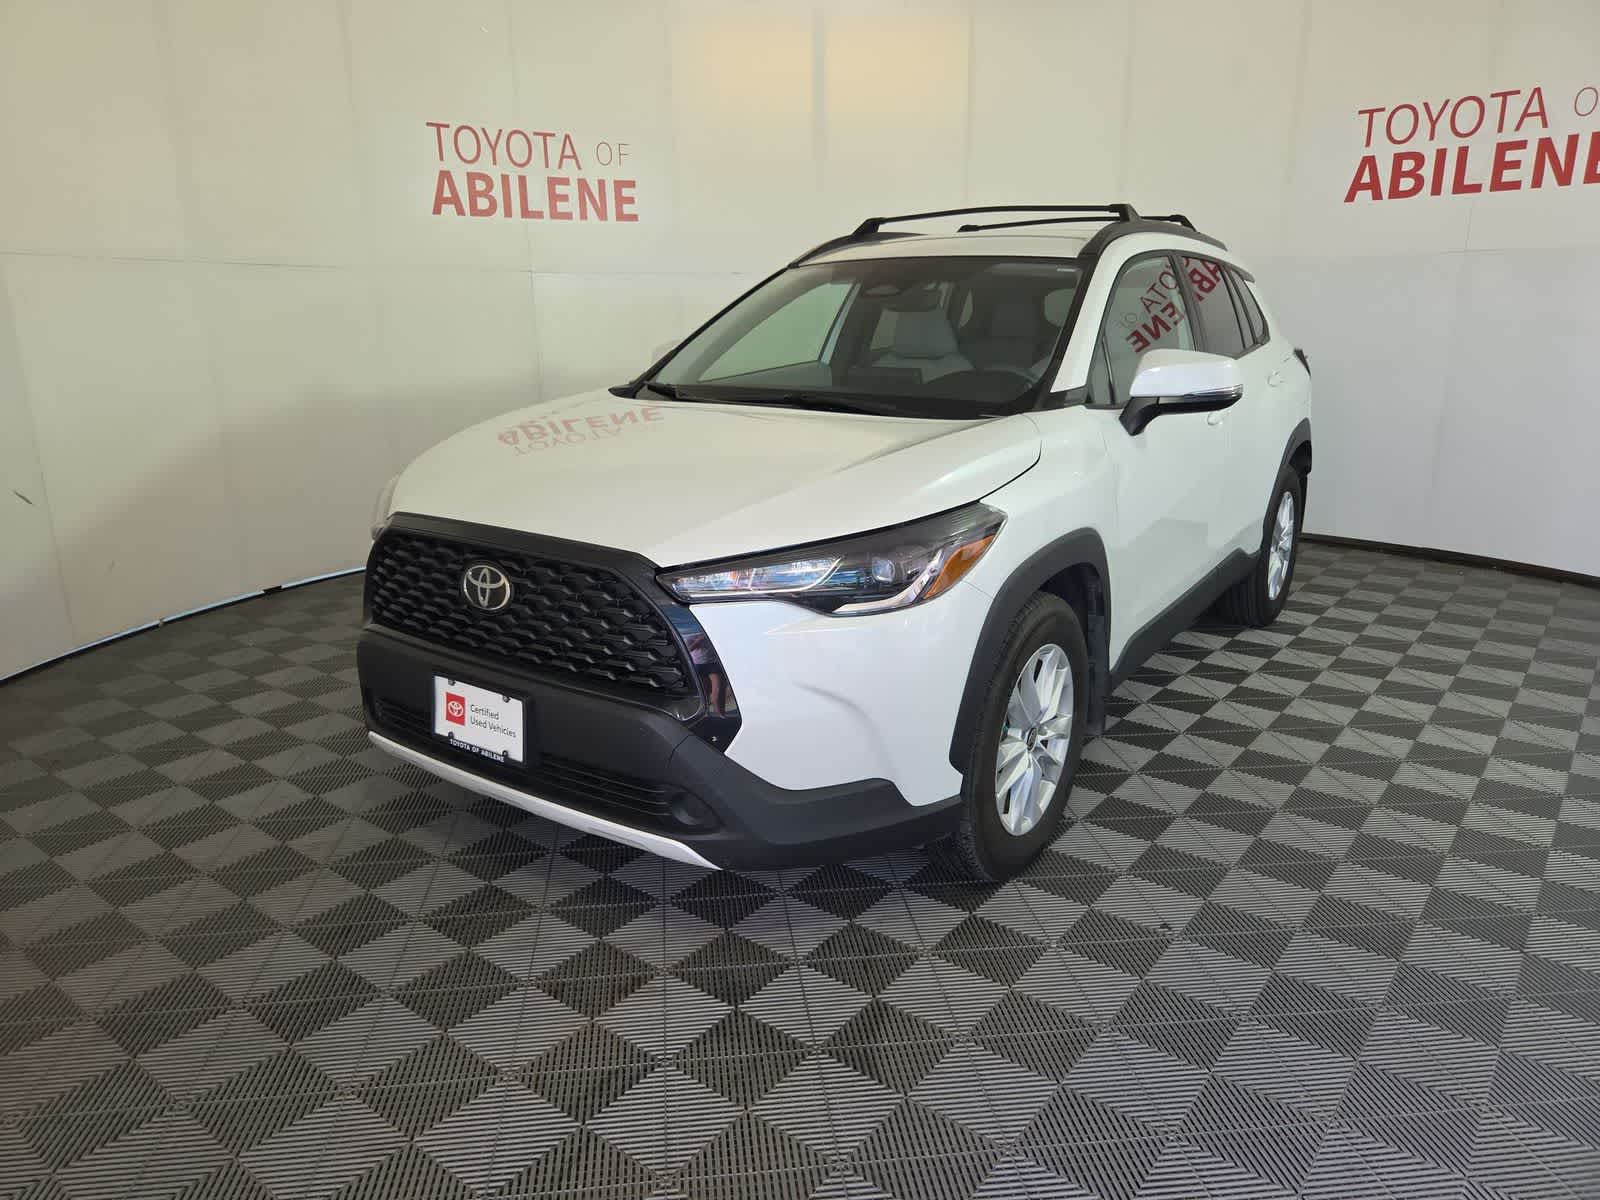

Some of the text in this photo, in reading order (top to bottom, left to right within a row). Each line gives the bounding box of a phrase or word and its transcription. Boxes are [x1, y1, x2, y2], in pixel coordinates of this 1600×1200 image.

[1358, 86, 1600, 148] TOYOTA O
[426, 122, 630, 170] TOYOTA OF
[432, 170, 639, 222] ABILENE
[470, 704, 500, 720] Certified
[471, 716, 517, 738] Used Vehicles
[449, 739, 471, 751] TOYOTA
[472, 746, 480, 754] OF
